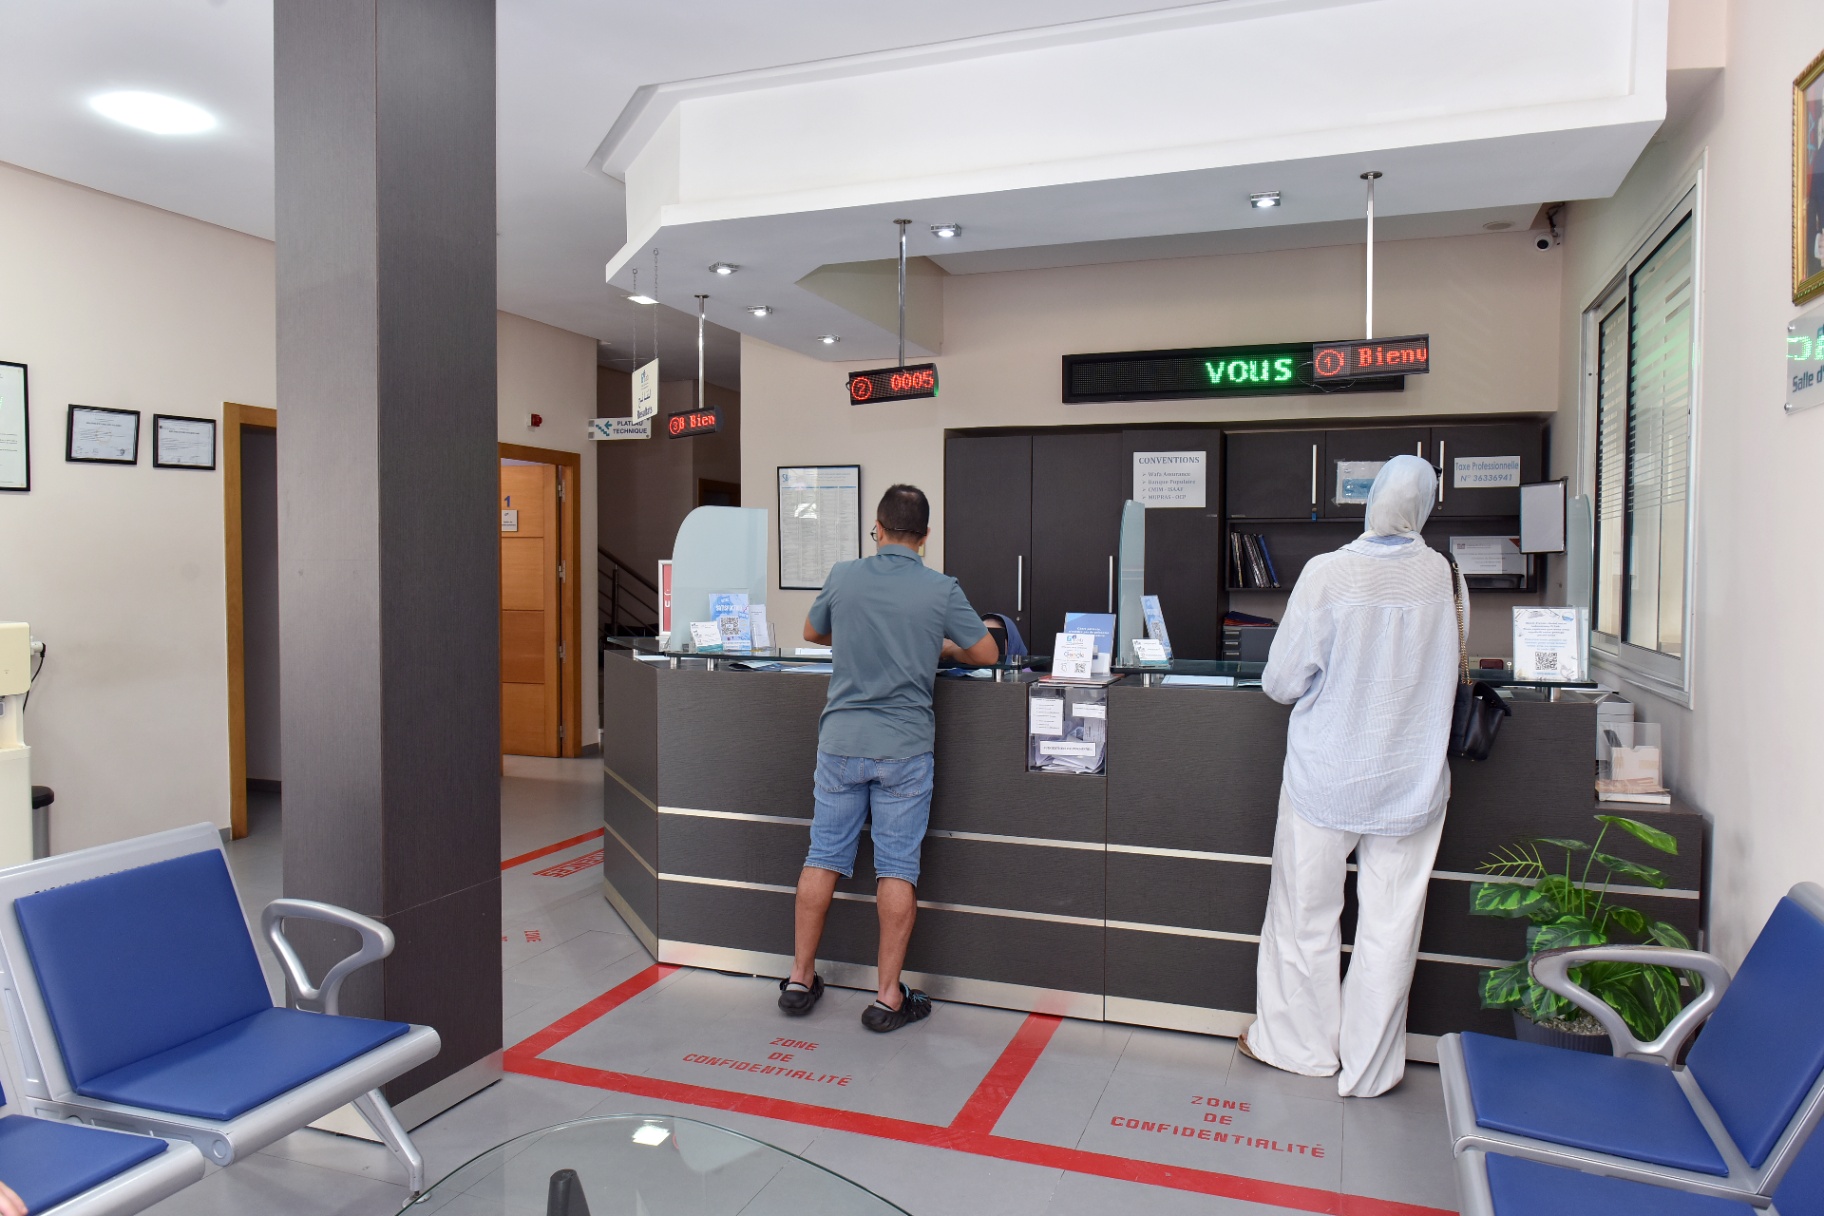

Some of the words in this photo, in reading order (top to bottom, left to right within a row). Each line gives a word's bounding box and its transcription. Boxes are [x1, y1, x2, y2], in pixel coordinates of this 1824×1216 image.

[890, 369, 934, 391] 0005
[1792, 371, 1814, 393] Salle
[689, 413, 715, 428] Bien
[1138, 456, 1200, 465] CONVENTIONS
[1455, 462, 1471, 471] Taxe
[1471, 460, 1519, 471] Professionnelle
[1472, 473, 1512, 482] 36336941
[504, 495, 511, 508] 1
[769, 1037, 819, 1051] ZONE
[767, 1051, 795, 1063] DE
[682, 1053, 853, 1087] CONFIDENTIALITÉ
[1191, 1095, 1252, 1112] ZONE
[1203, 1112, 1233, 1126] DE
[1110, 1115, 1325, 1158] CONFIDENTIALITÉ
